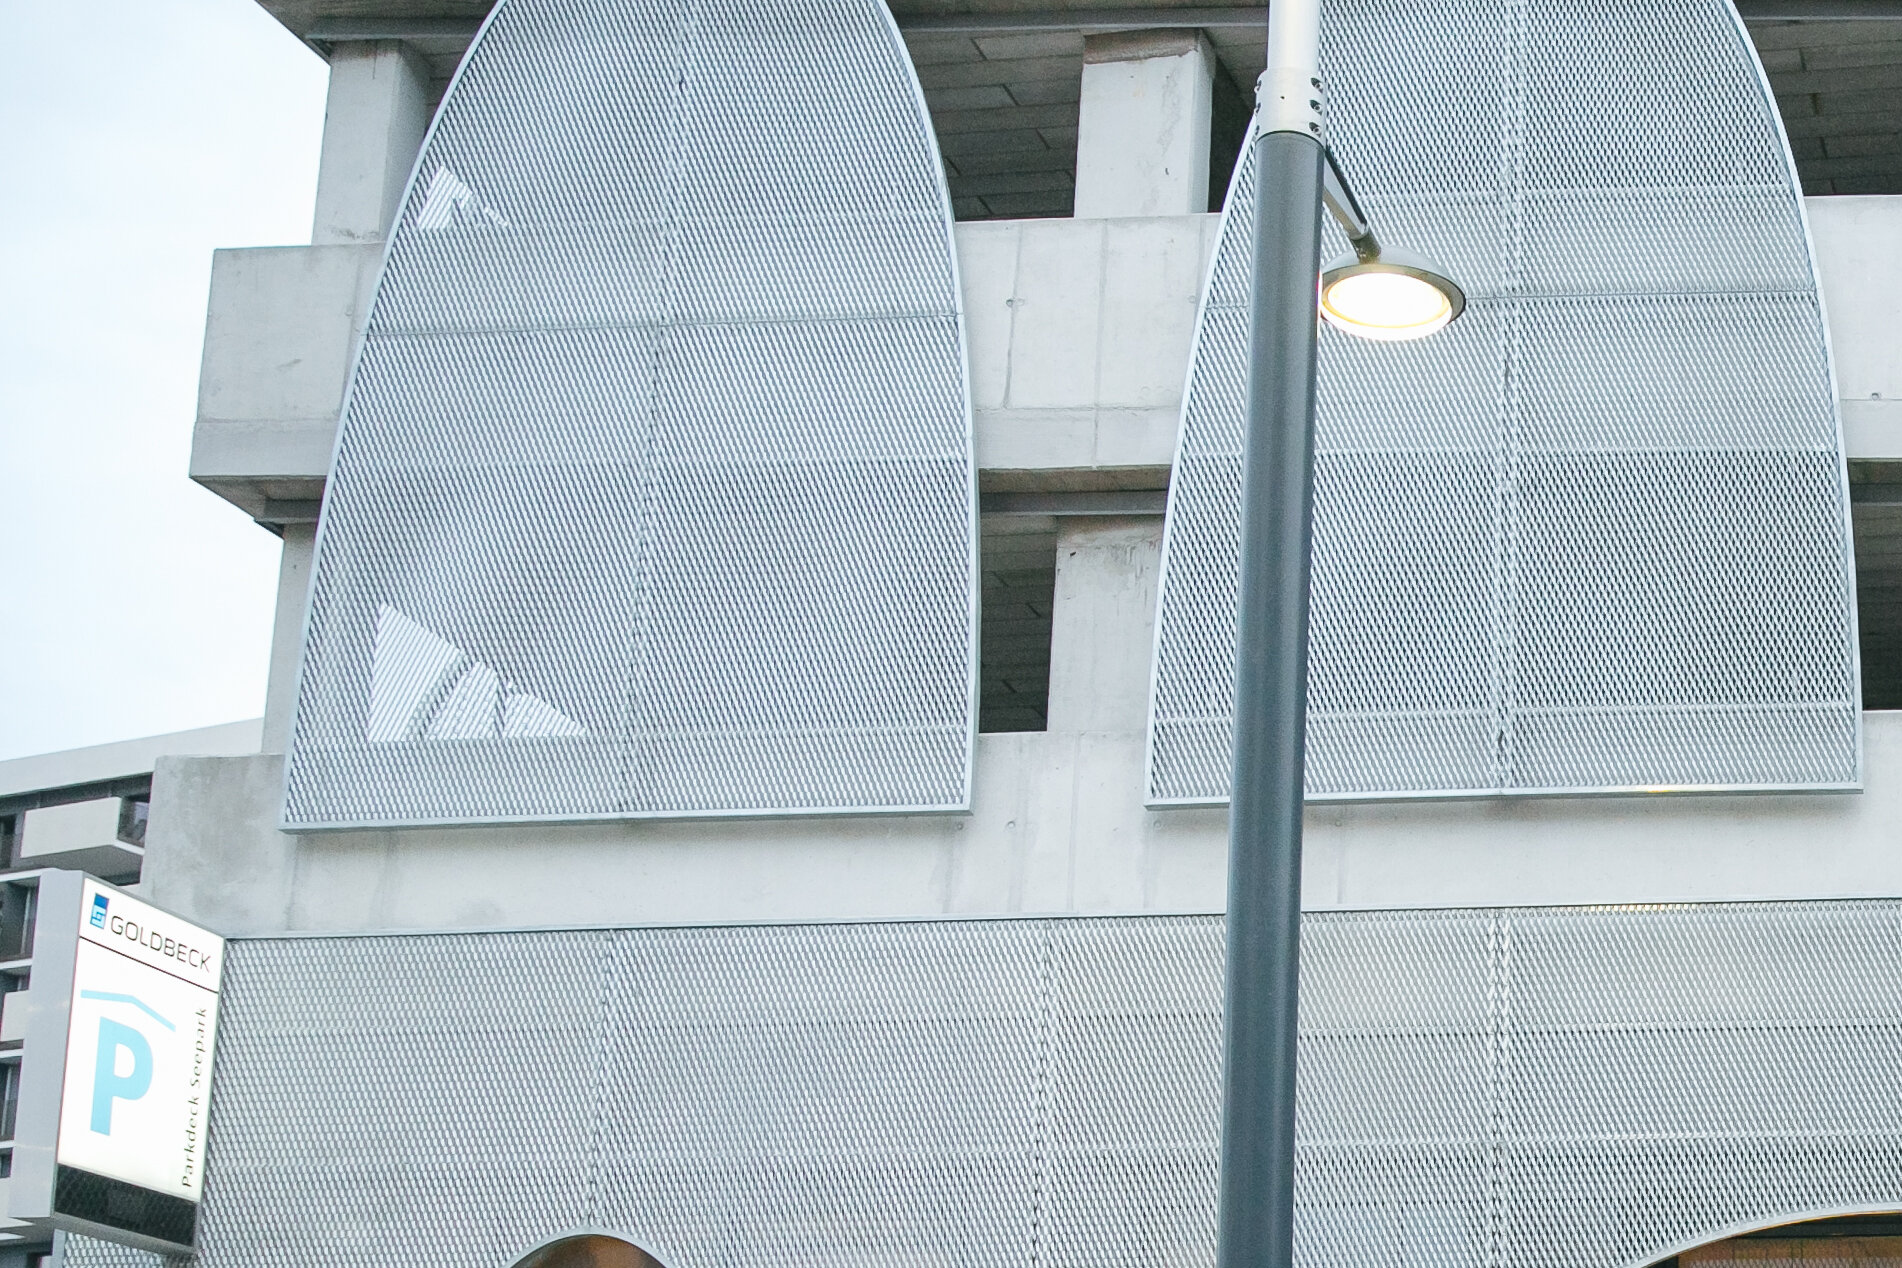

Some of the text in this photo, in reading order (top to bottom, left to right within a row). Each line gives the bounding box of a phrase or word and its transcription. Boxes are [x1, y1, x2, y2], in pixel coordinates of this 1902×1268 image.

[110, 915, 211, 973] GOLDBECK
[90, 1016, 154, 1136] P
[181, 1006, 208, 1188] Parkdeck Seepark
